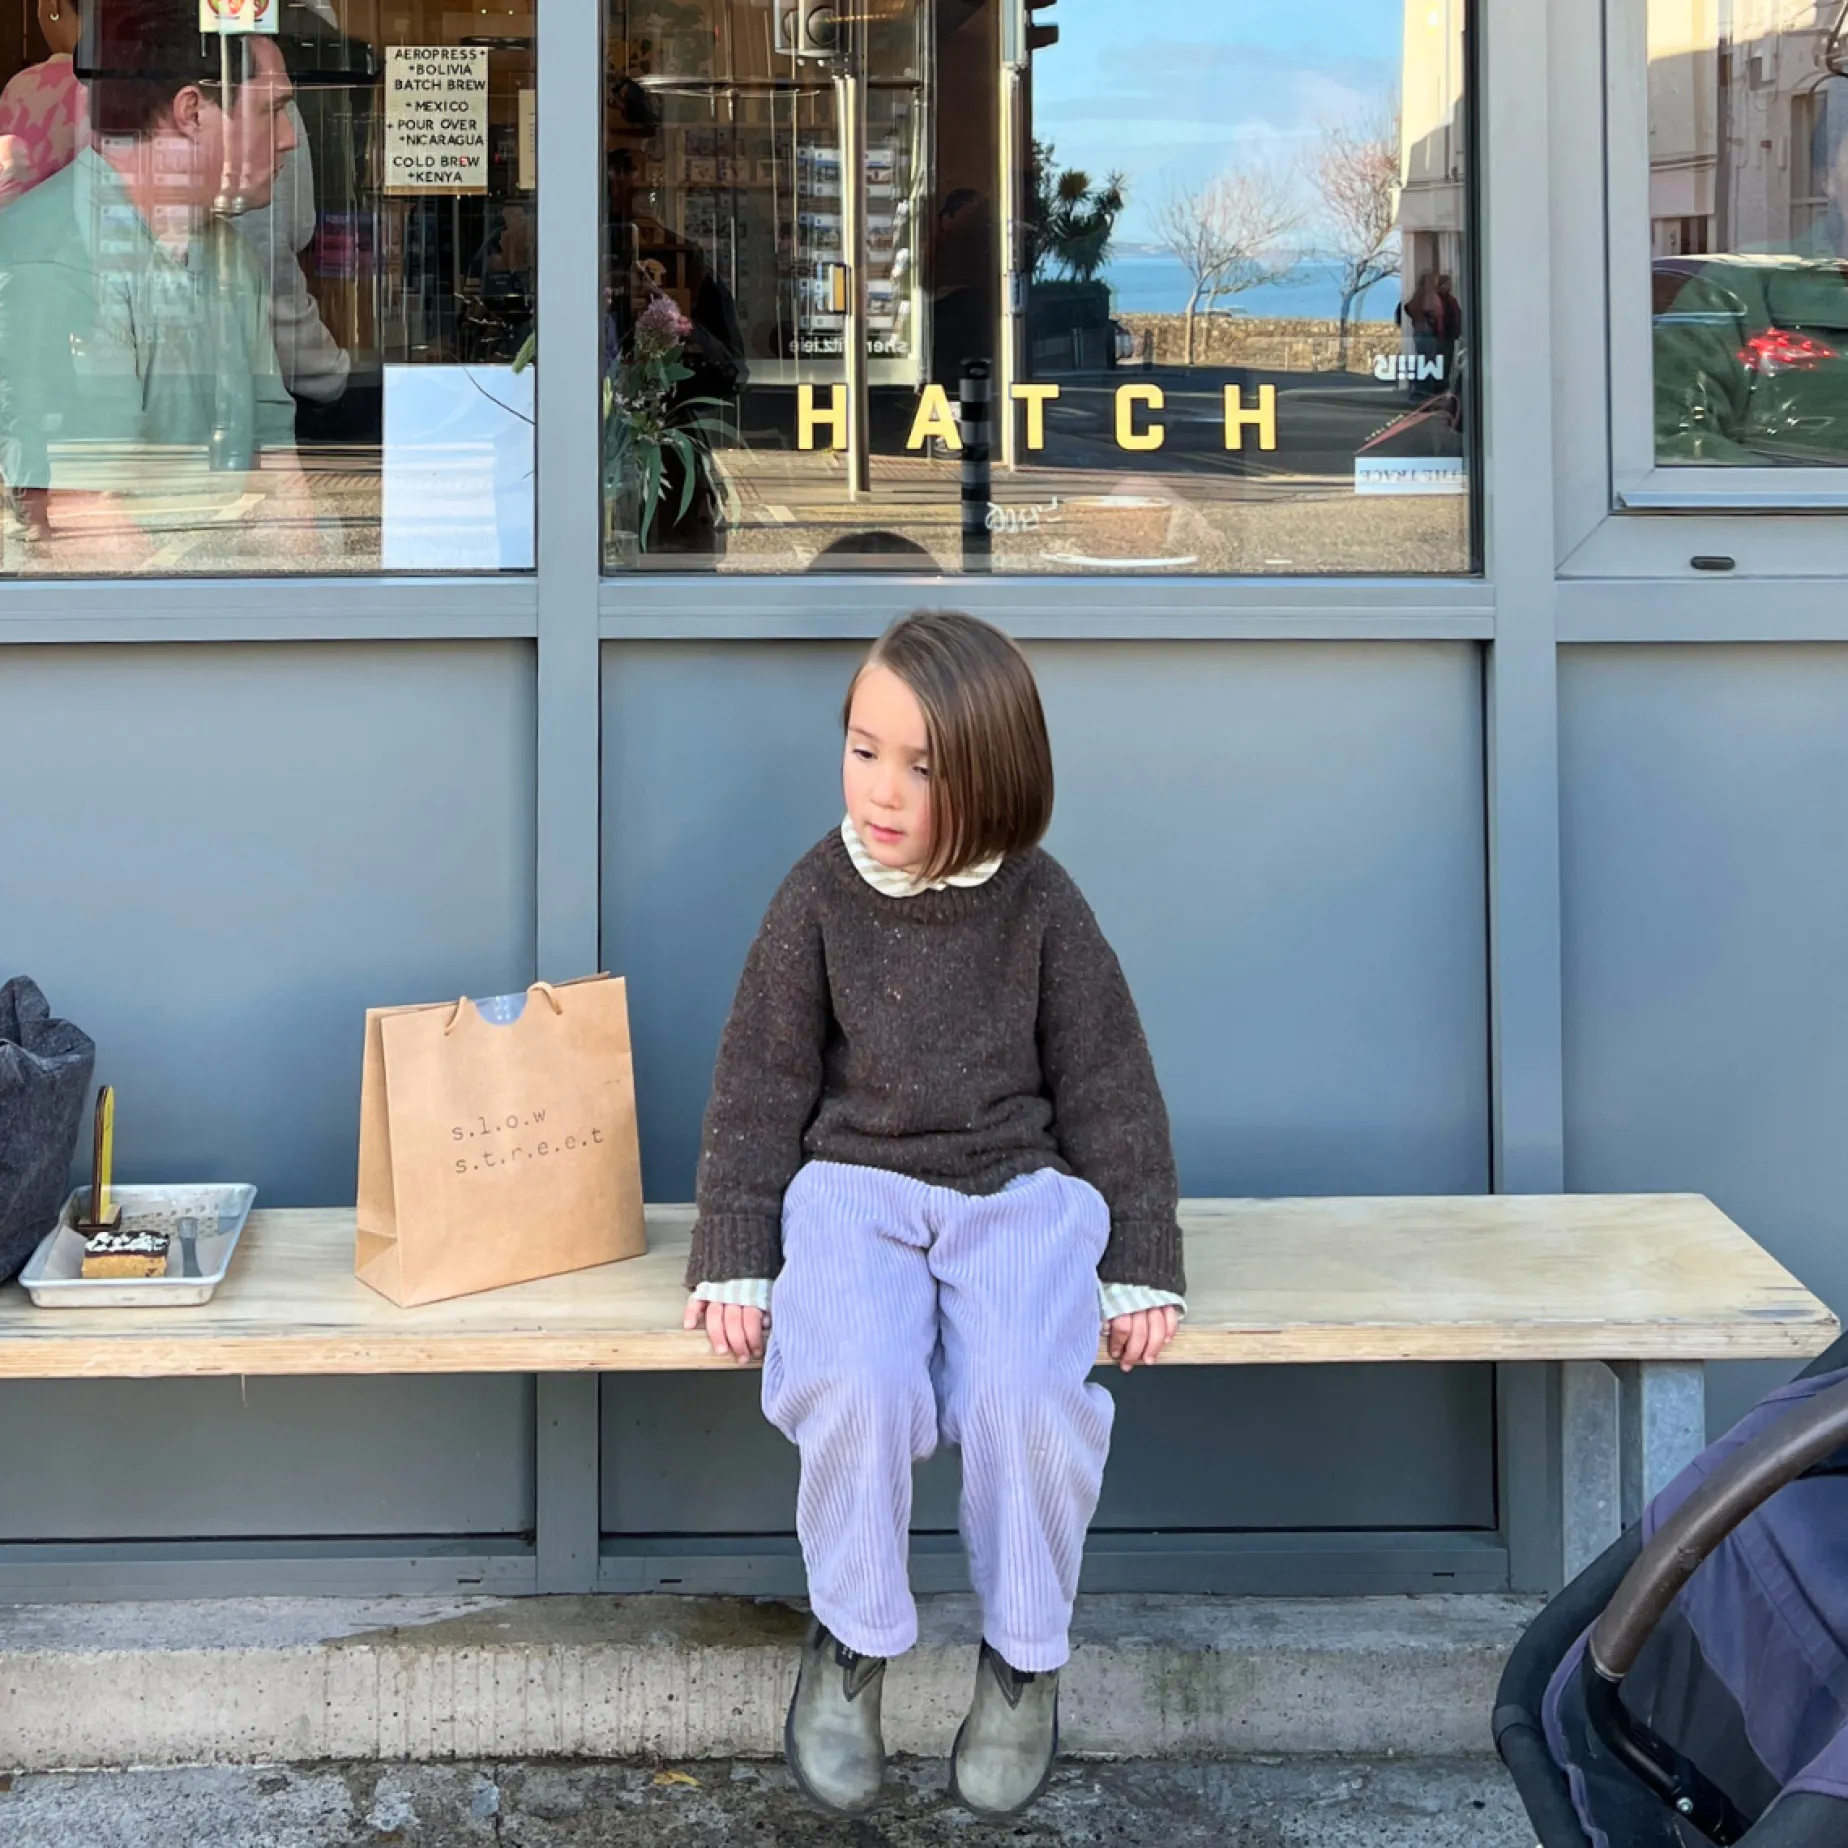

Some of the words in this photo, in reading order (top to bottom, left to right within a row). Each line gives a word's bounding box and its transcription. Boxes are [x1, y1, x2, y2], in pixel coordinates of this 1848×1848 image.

[395, 79, 442, 90] BATCH
[447, 79, 486, 90] BREW
[398, 119, 434, 130] POUR
[440, 118, 477, 130] OVER
[393, 156, 435, 168] COLD
[440, 155, 480, 168] BREW
[1372, 354, 1445, 381] MiiR
[796, 382, 1278, 451] HATCH
[451, 1109, 546, 1141] s.l.o.w
[455, 1127, 604, 1174] s.t.r.e.e.t
